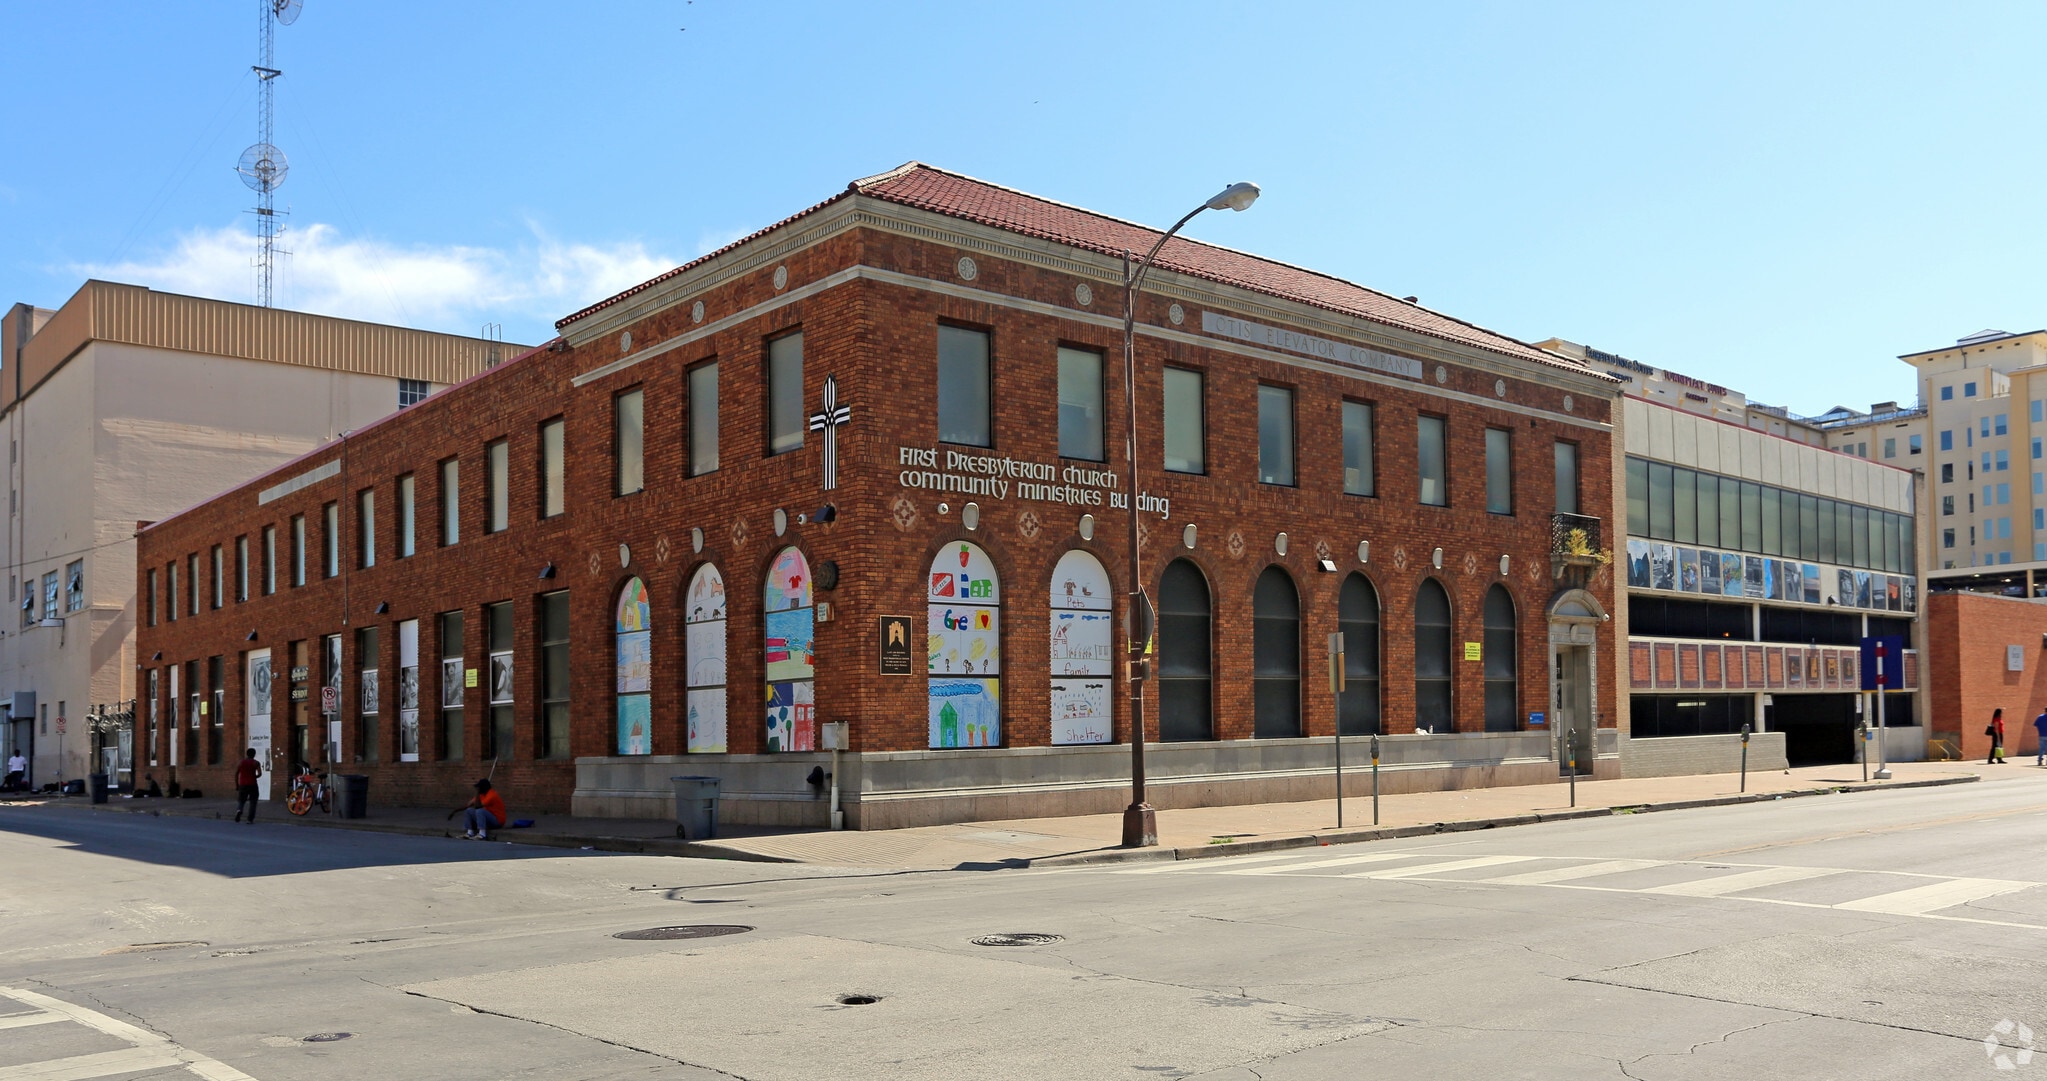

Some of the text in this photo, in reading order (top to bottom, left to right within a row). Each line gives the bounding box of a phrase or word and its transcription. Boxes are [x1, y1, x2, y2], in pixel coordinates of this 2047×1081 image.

[1216, 316, 1411, 374] OTIS ELEVATOR COMPANY
[1066, 596, 1085, 608] Pets
